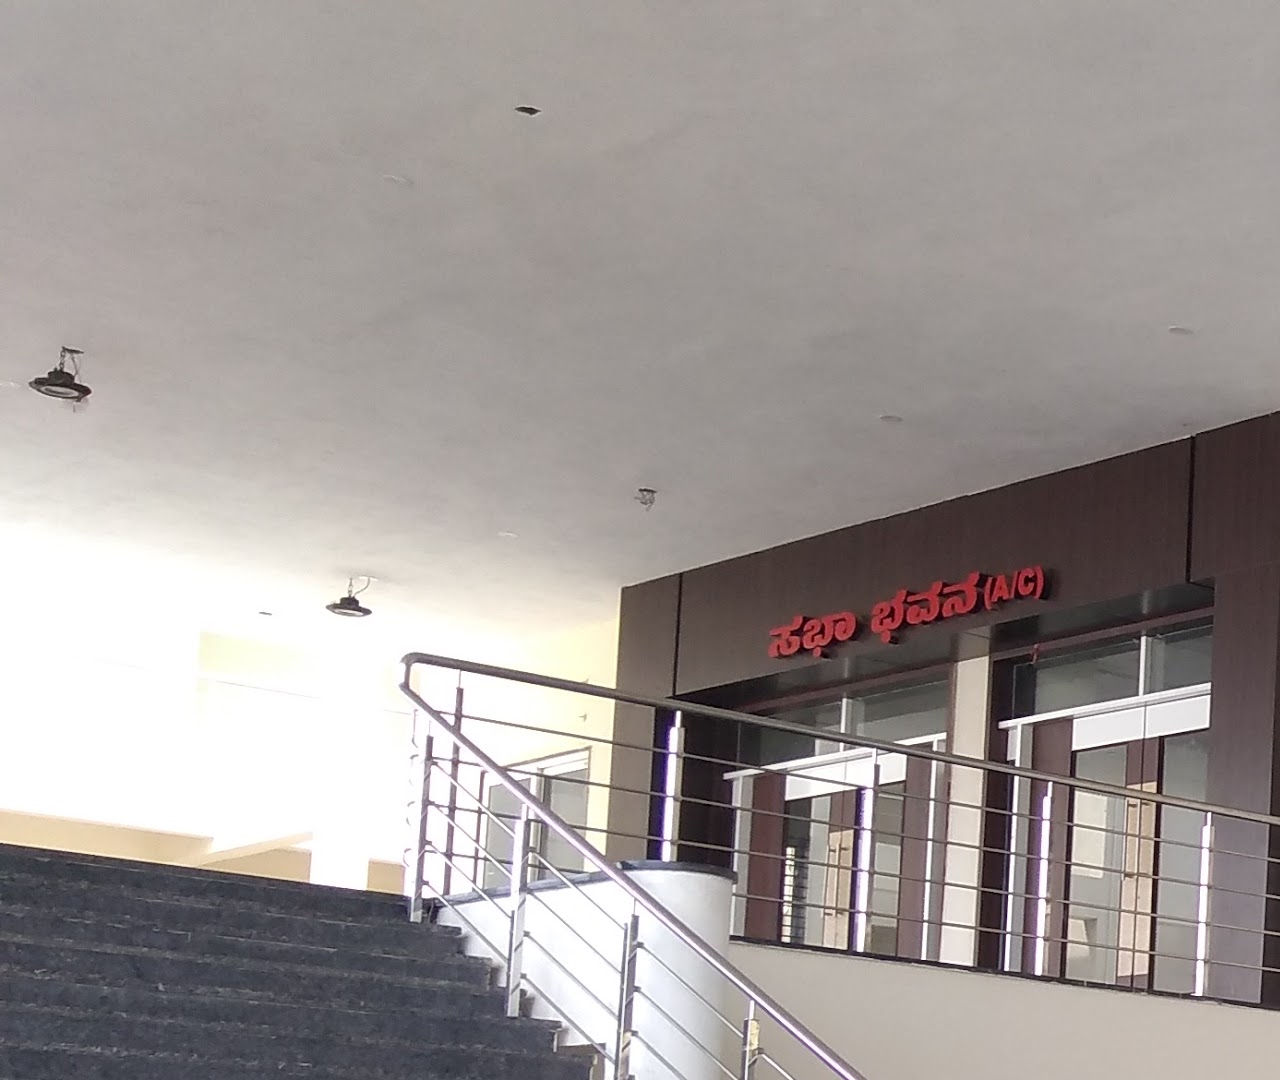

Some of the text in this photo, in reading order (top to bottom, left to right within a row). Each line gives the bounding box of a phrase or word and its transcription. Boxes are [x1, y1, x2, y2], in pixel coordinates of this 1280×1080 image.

[767, 565, 1045, 658] ಸಭಾ ಭವನ (A/C)
